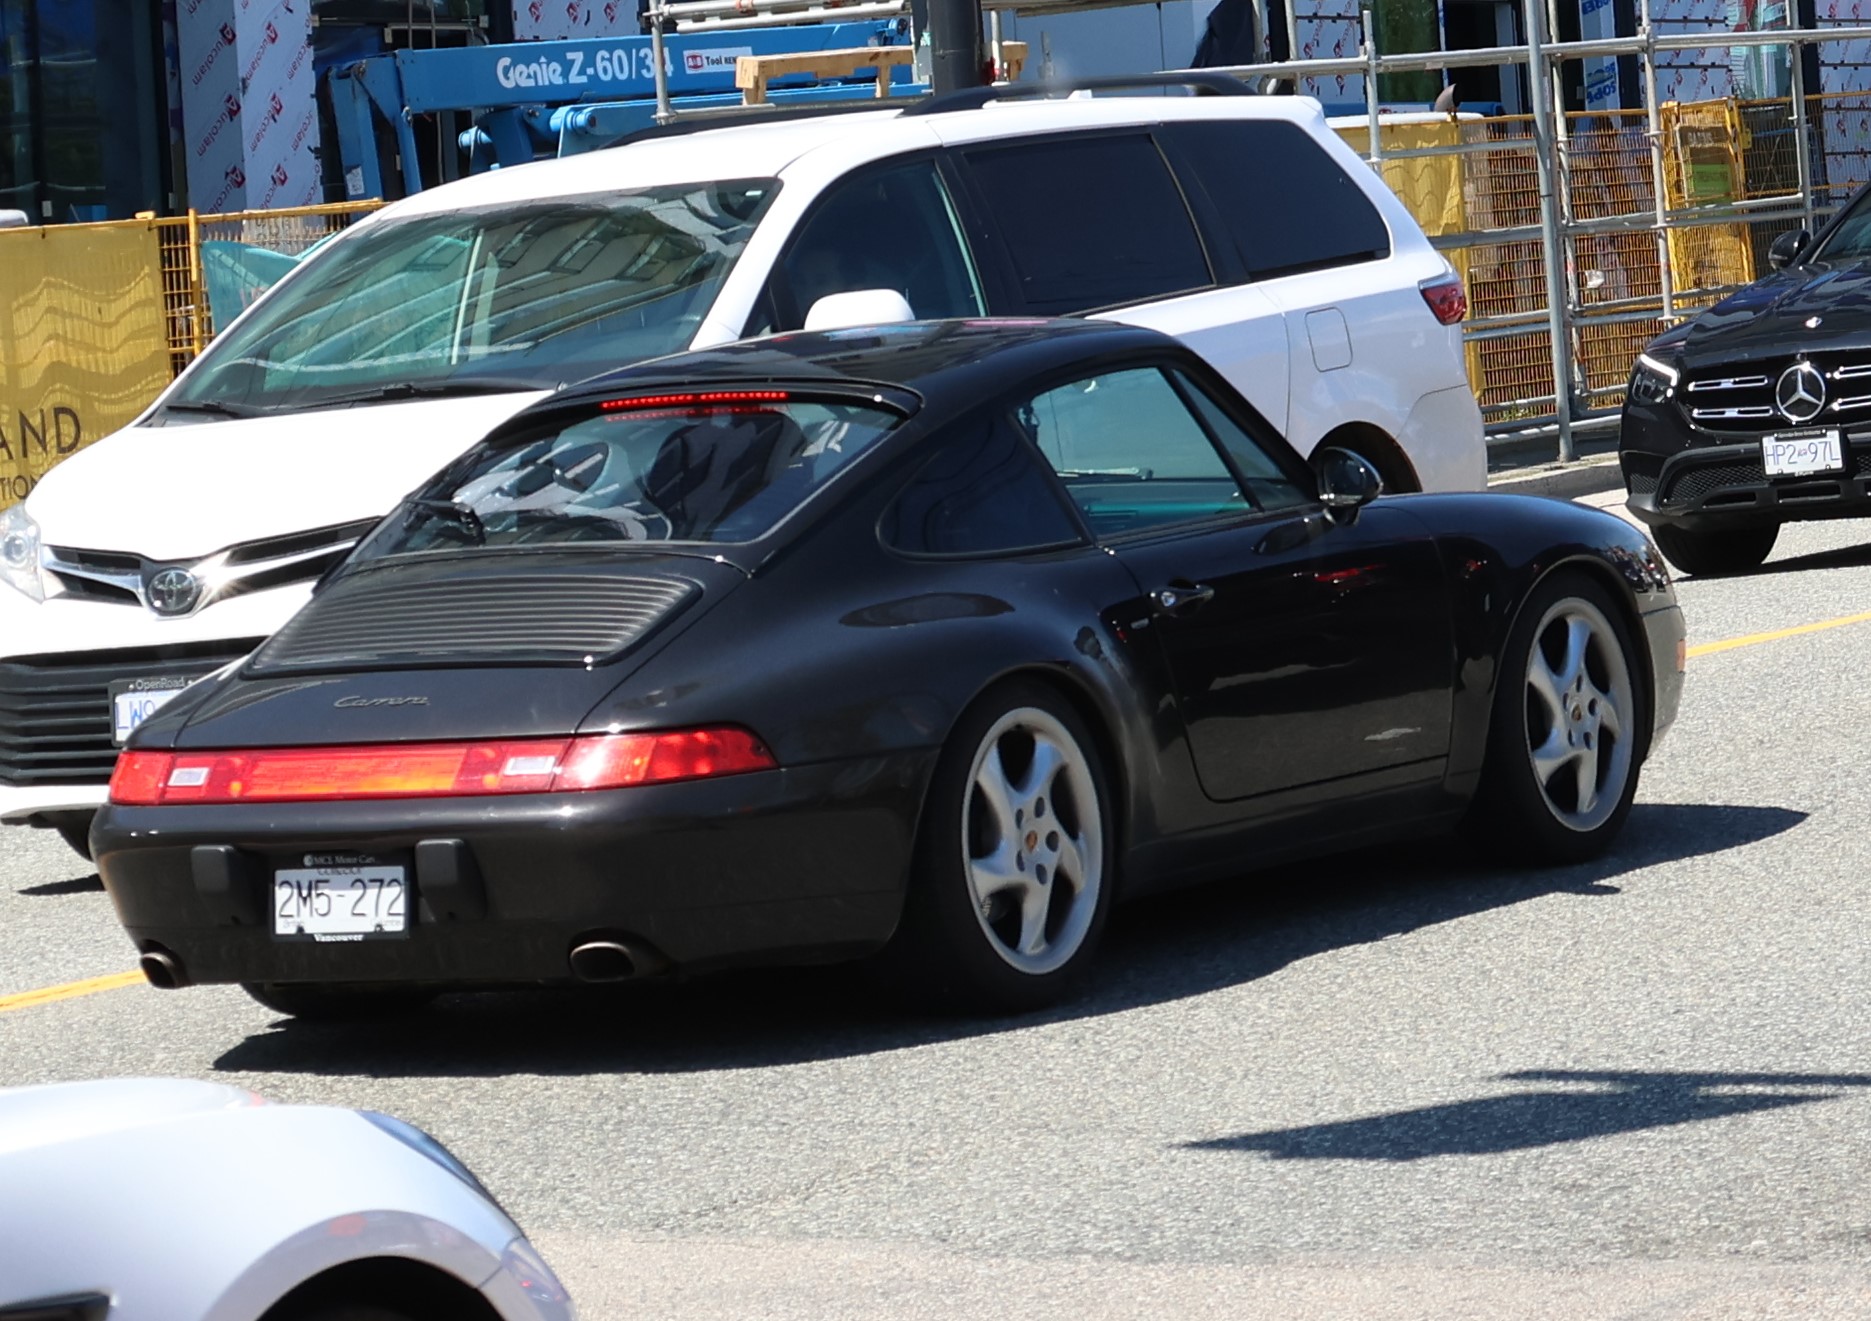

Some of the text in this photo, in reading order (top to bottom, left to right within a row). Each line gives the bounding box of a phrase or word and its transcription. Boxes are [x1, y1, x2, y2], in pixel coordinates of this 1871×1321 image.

[705, 55, 723, 66] Tool
[496, 56, 564, 89] Genie
[135, 676, 185, 691] OpenRoad
[333, 695, 431, 708] Carrera
[278, 878, 404, 918] 2M5-272
[313, 933, 364, 942] Vancouver
